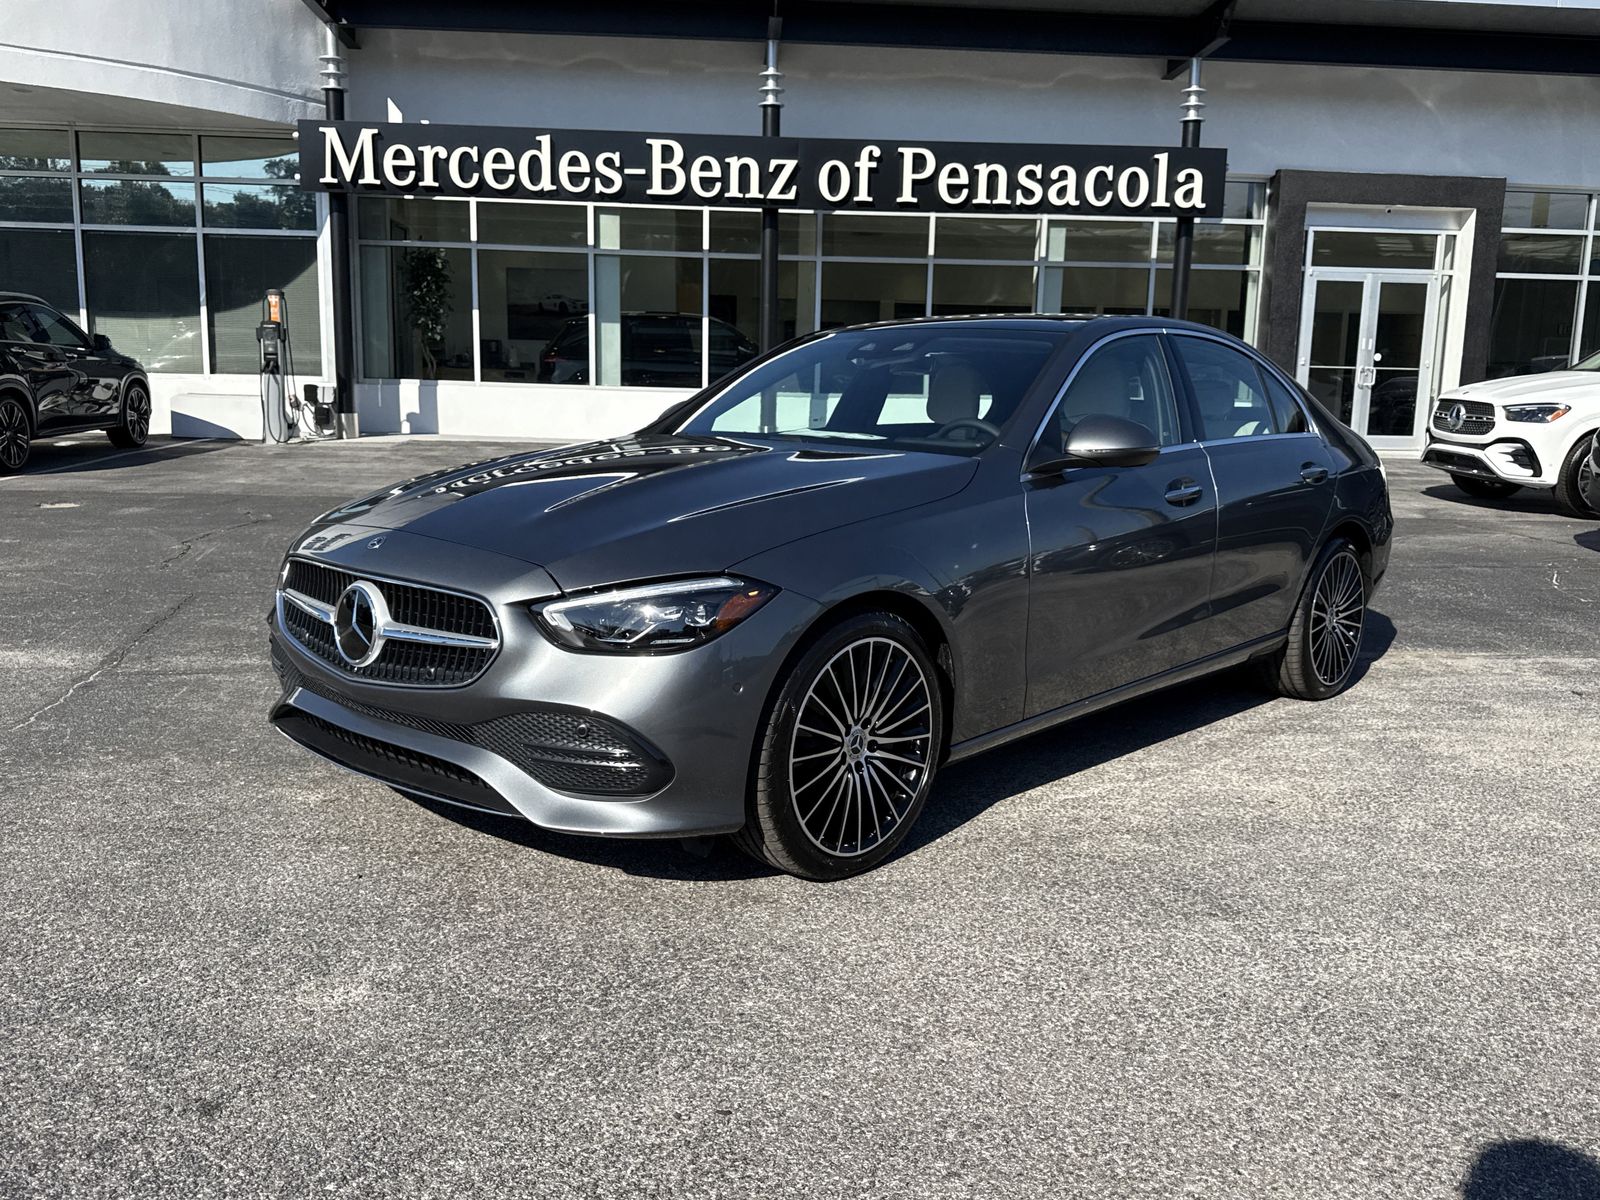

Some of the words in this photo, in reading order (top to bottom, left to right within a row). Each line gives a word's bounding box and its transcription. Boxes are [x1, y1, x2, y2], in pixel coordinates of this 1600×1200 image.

[319, 127, 799, 200] Mercedes-Benz
[819, 145, 882, 202] of
[897, 147, 1206, 209] Pensacola
